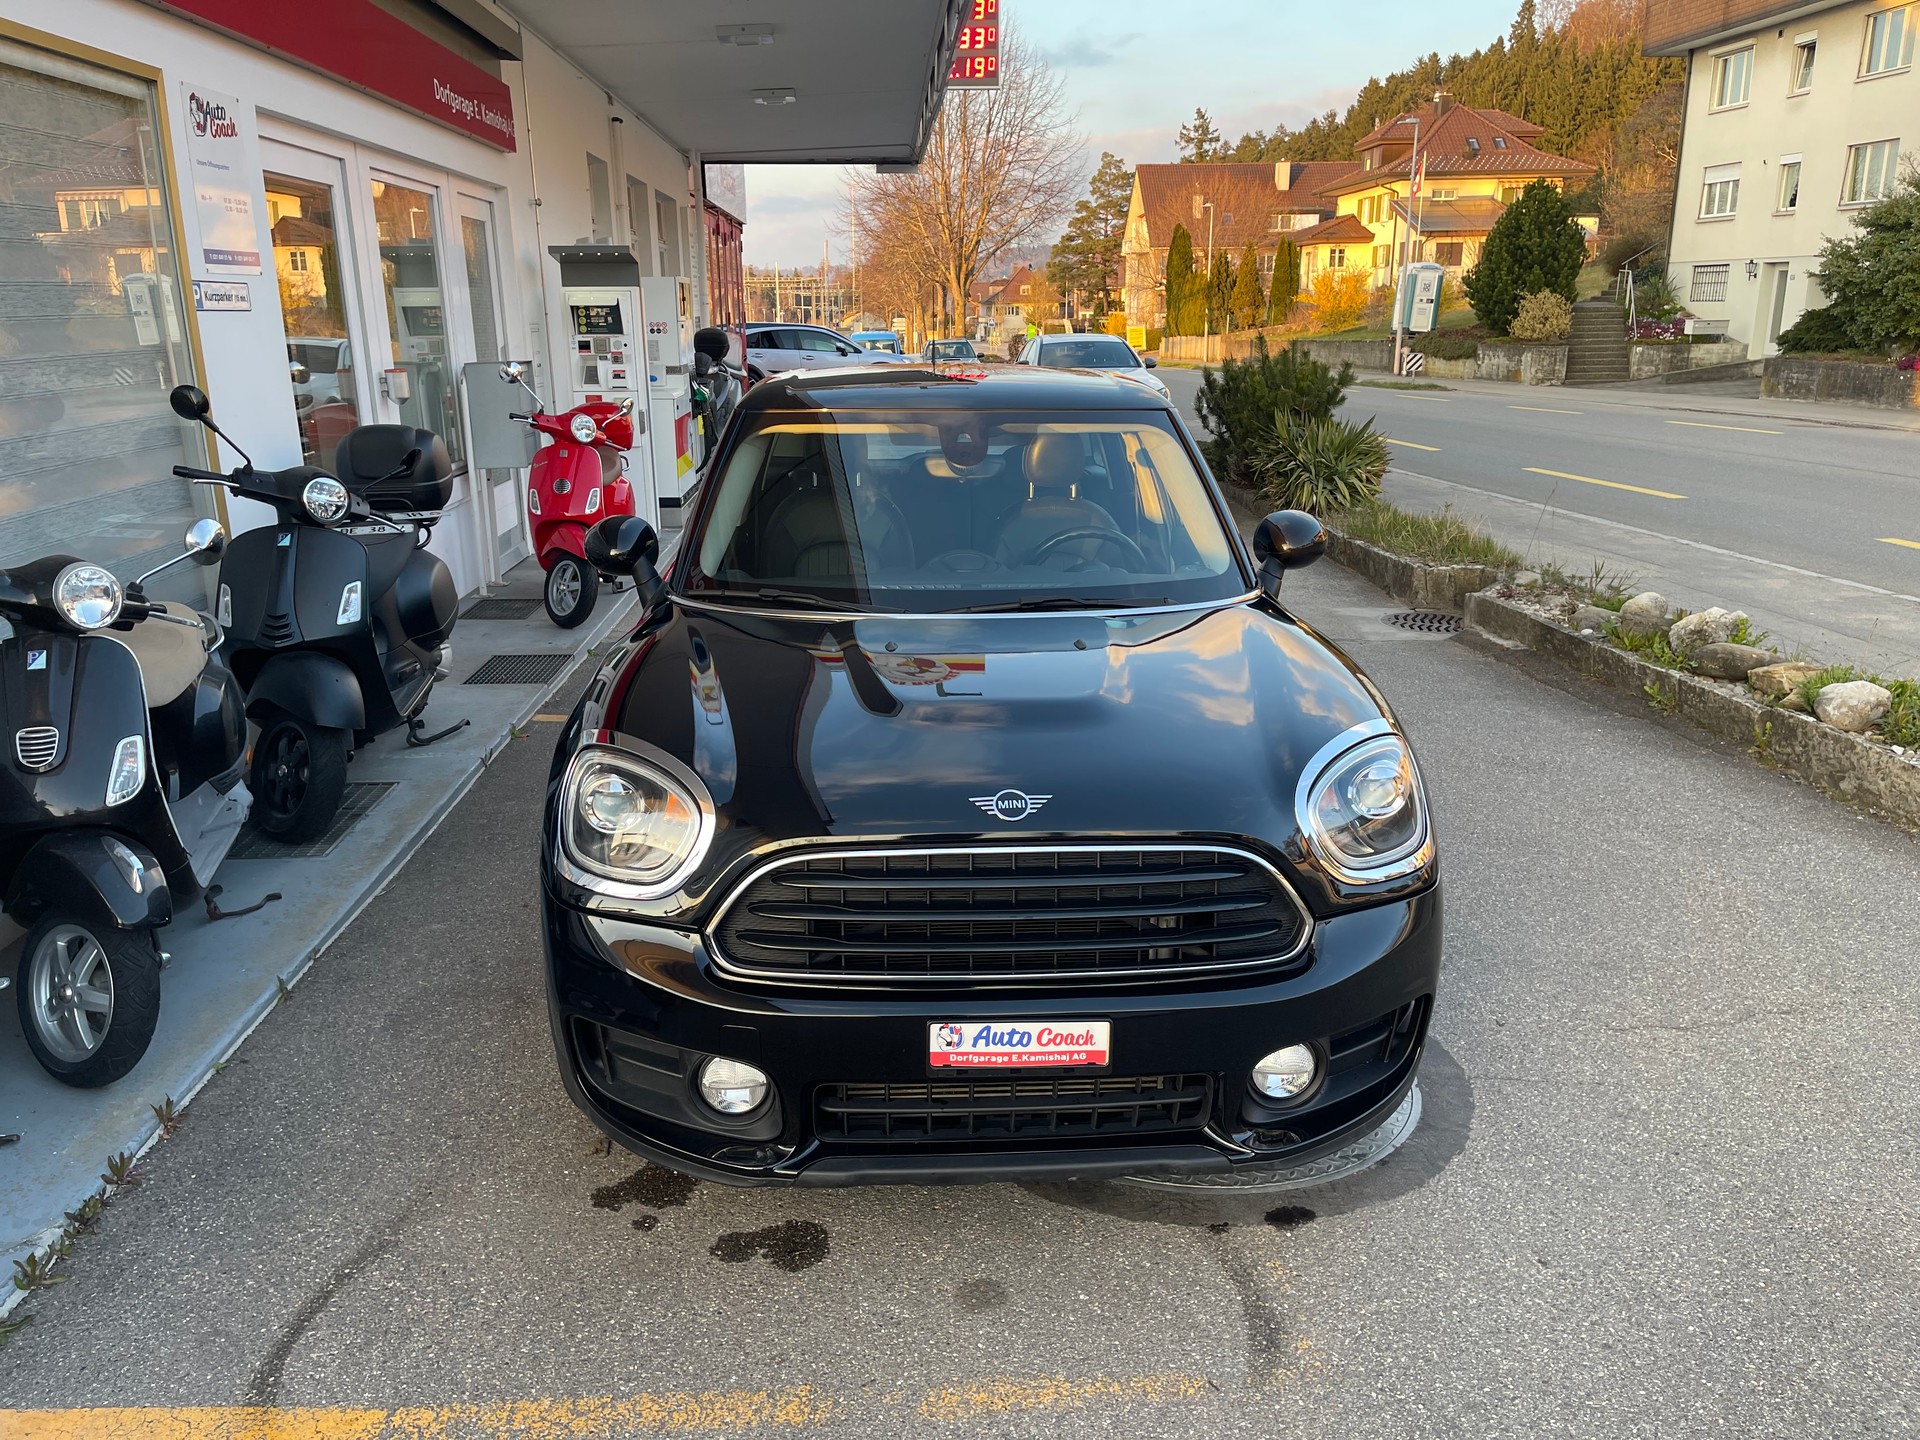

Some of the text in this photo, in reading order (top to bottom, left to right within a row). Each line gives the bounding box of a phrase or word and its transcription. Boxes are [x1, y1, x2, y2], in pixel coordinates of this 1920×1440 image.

[434, 78, 474, 120] Dorfgarage
[205, 100, 226, 122] Auto
[210, 116, 238, 138] Coach
[204, 291, 234, 305] Kurzparker
[997, 799, 1026, 809] MINI
[971, 1025, 1096, 1048] Auto Coach
[949, 1053, 1009, 1063] Dorfgarage
